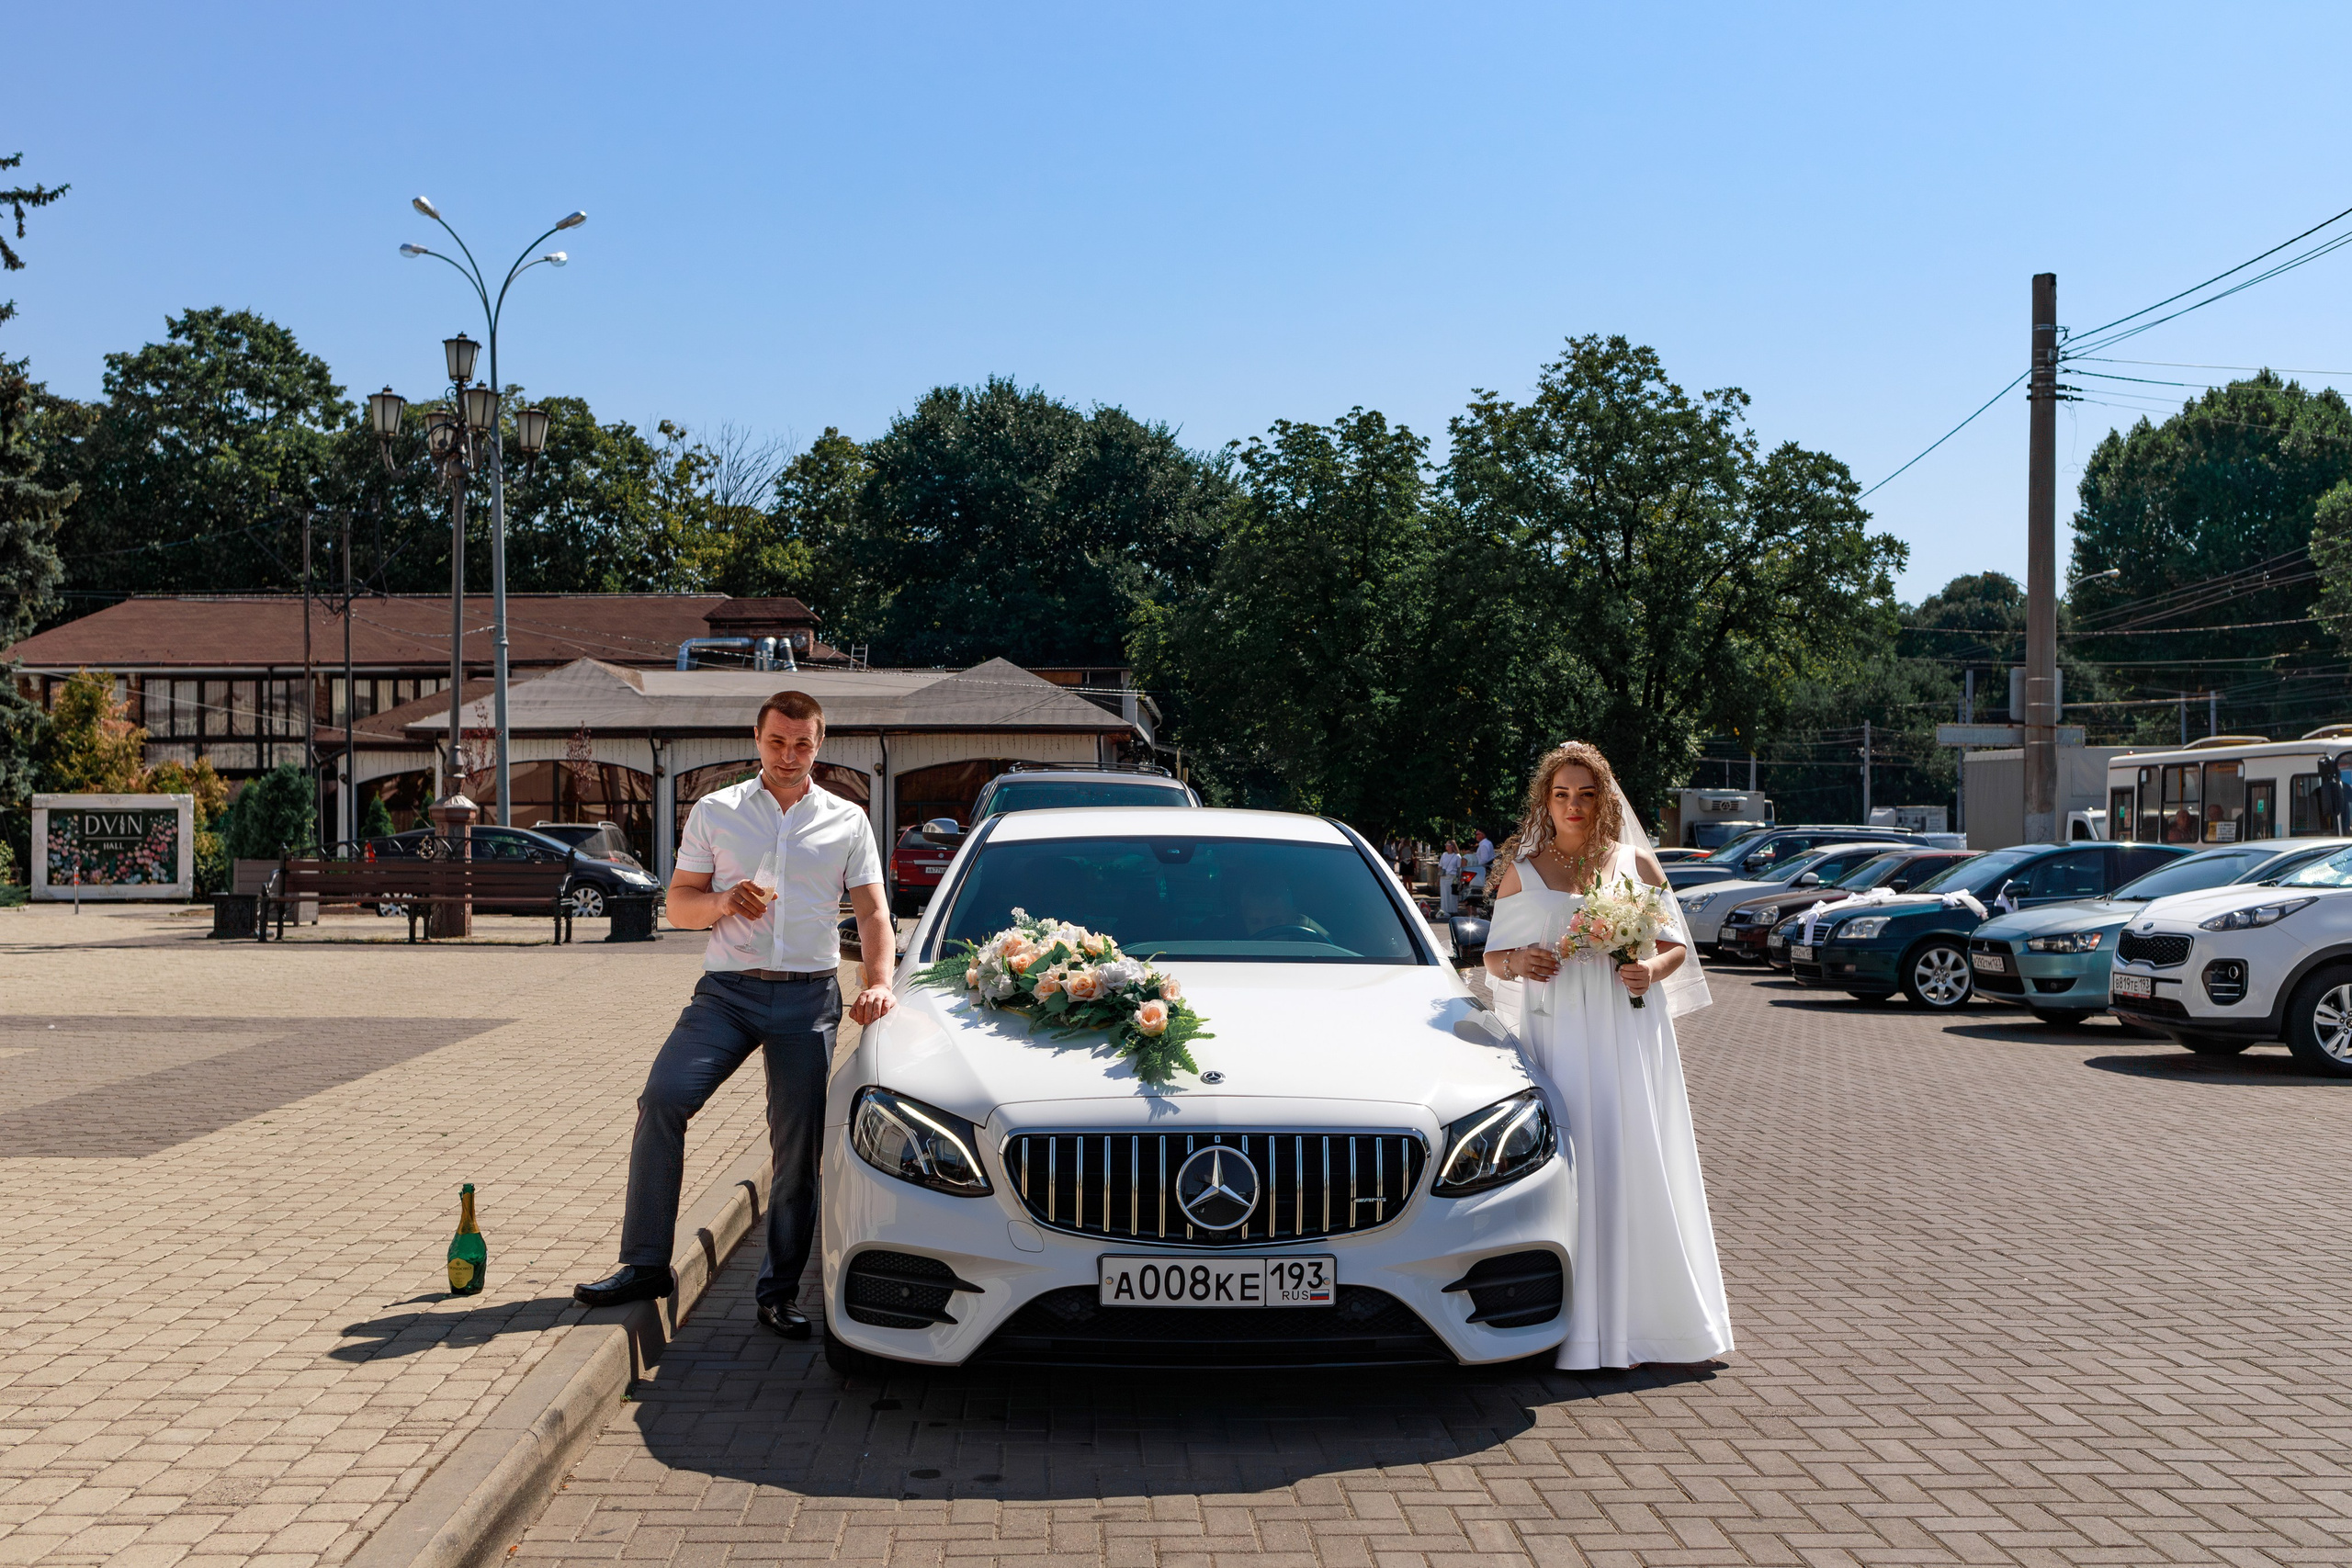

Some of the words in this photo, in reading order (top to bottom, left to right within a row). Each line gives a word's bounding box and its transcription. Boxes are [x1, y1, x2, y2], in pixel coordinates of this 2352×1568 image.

[85, 814, 142, 835] DVIN
[103, 842, 125, 851] HALL
[2115, 976, 2138, 991] В819ТЕ
[2140, 978, 2150, 989] 193
[1114, 1264, 1260, 1301] А008КЕ
[1270, 1261, 1323, 1290] 193
[1282, 1290, 1309, 1301] RUS
